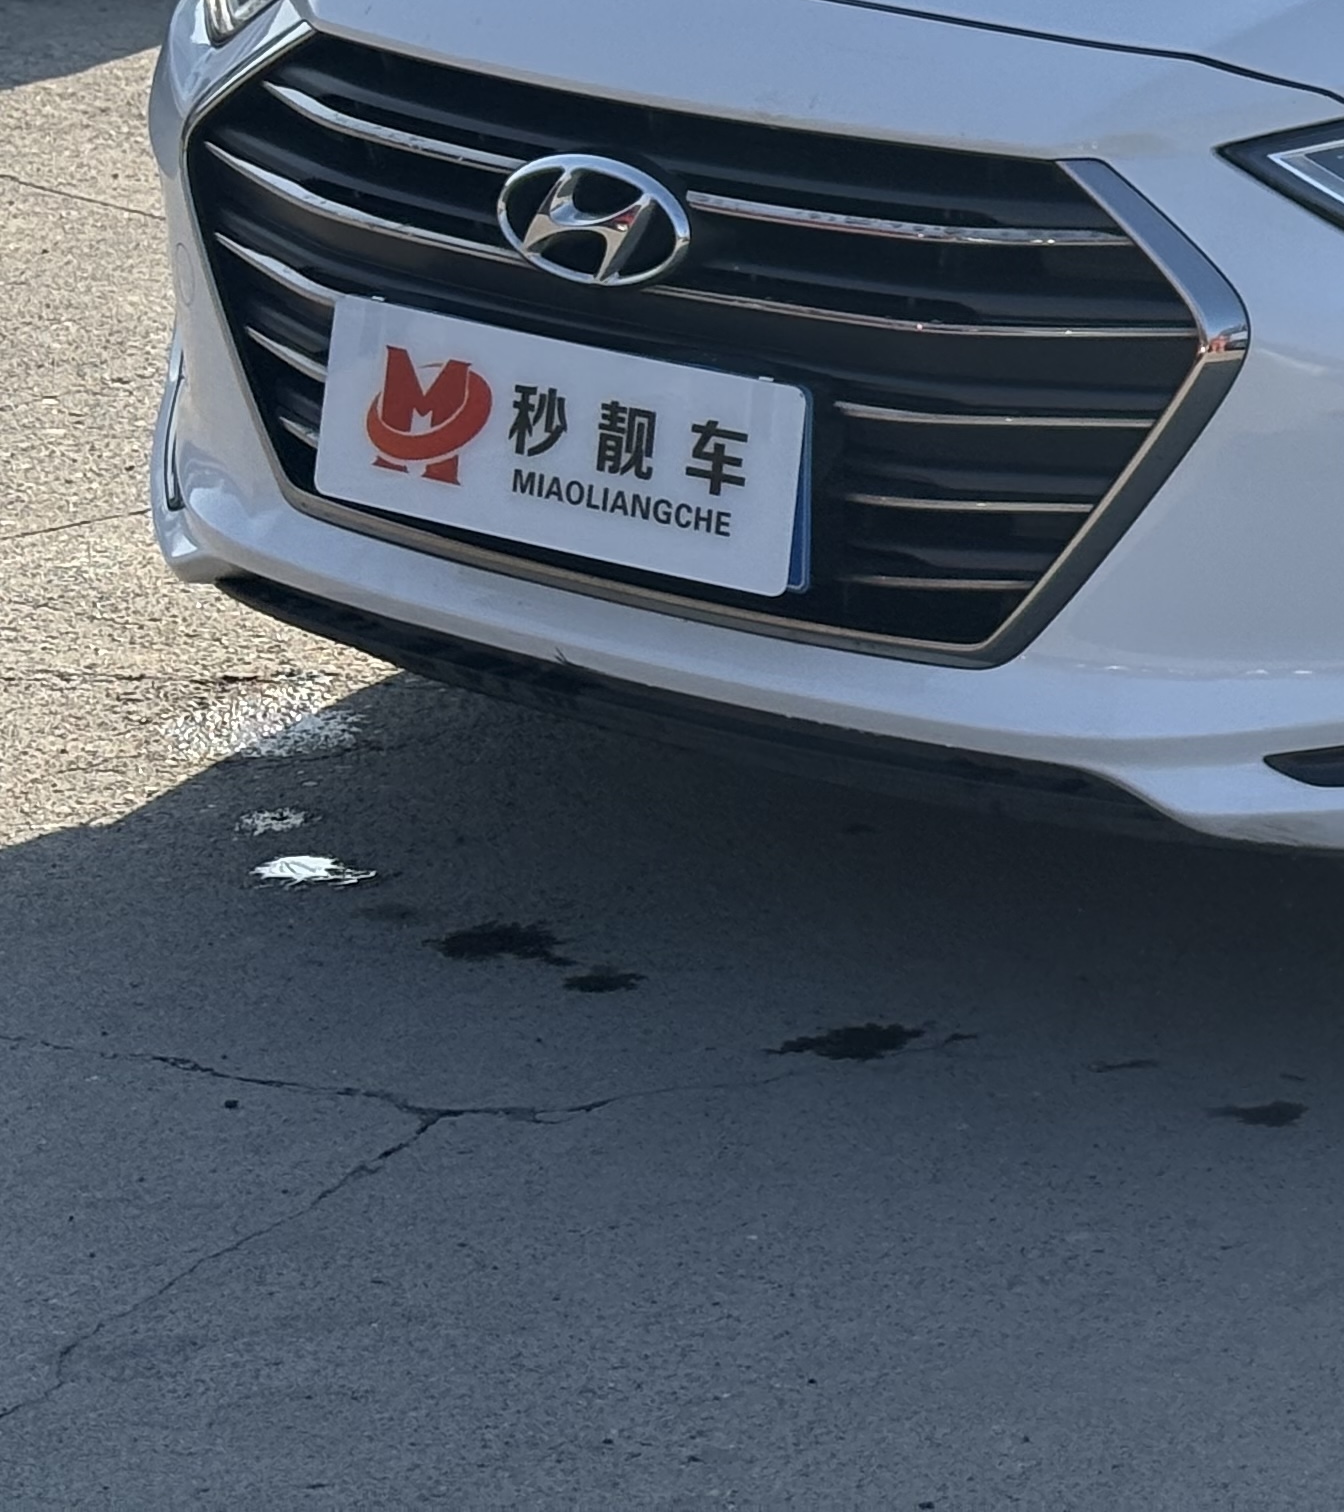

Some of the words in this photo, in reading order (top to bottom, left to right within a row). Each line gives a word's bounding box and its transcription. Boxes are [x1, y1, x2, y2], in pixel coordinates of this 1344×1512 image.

[508, 383, 749, 497] 秒靓车
[511, 470, 732, 537] MIAOLIANGCHE
